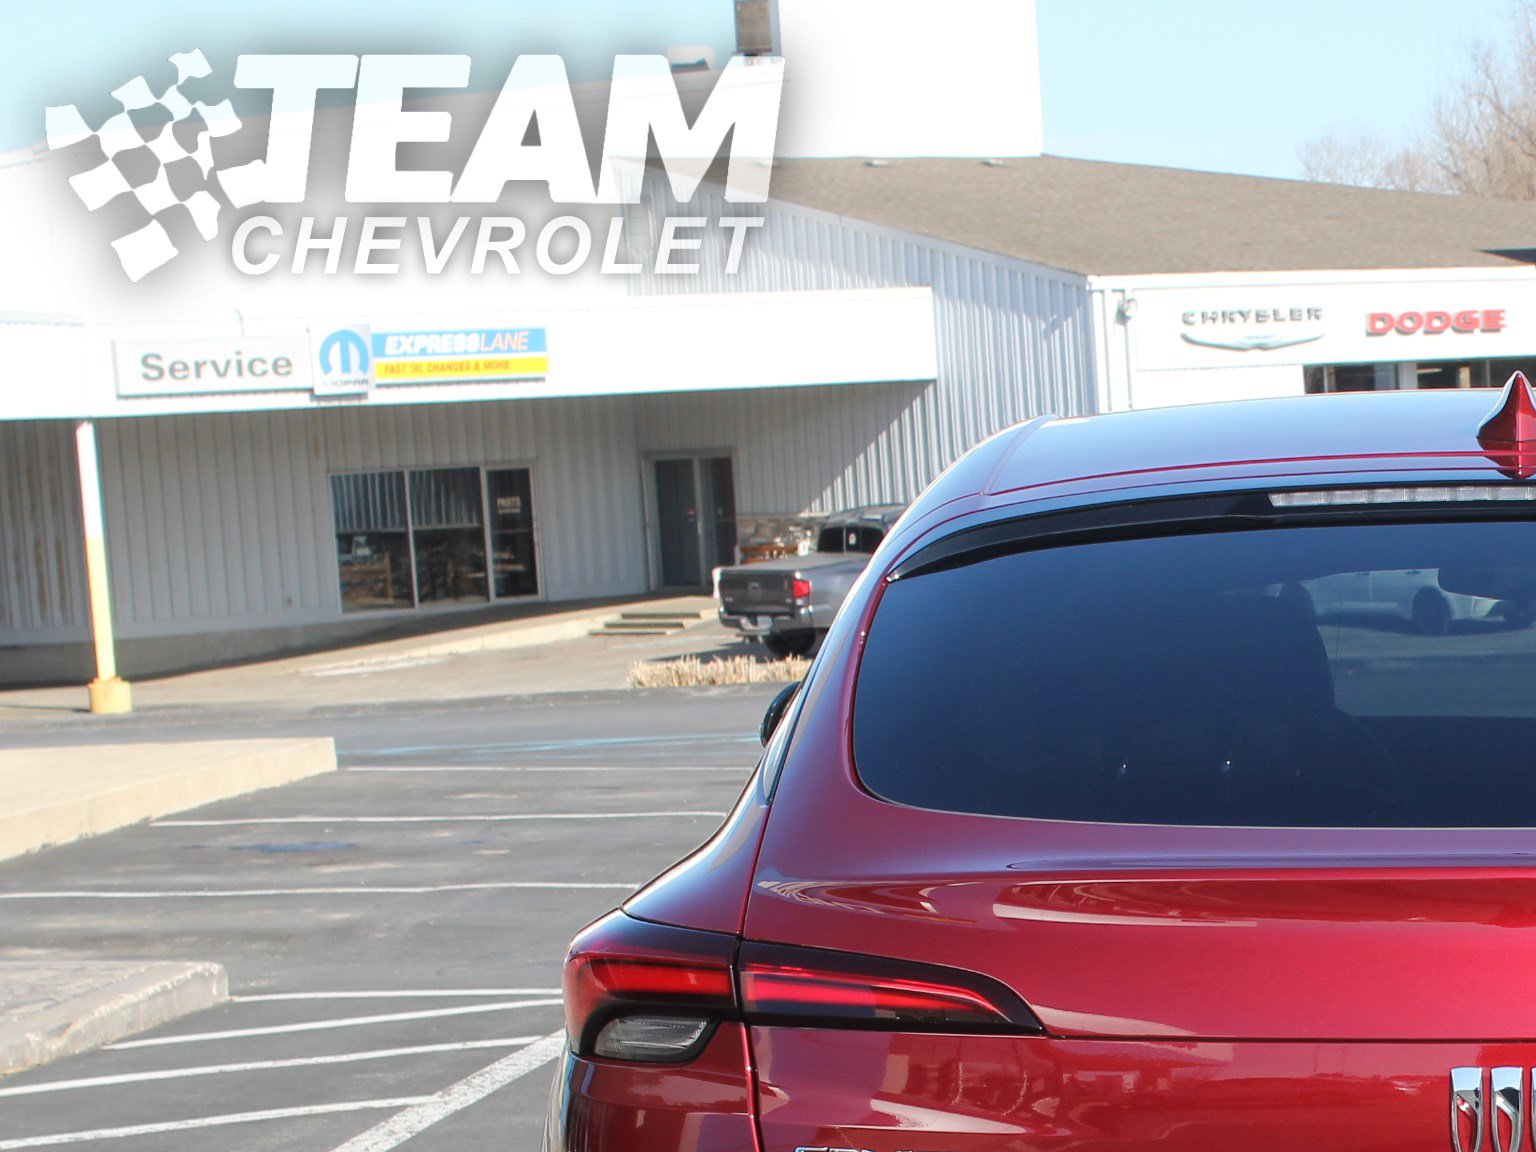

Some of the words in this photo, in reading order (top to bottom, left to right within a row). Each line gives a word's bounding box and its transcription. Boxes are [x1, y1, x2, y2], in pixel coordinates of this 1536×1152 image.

[1181, 307, 1323, 326] CHRYSLER
[1365, 308, 1507, 337] DODGE
[140, 351, 293, 382] Service
[426, 361, 471, 373] CHANGES
[483, 360, 511, 371] MORE
